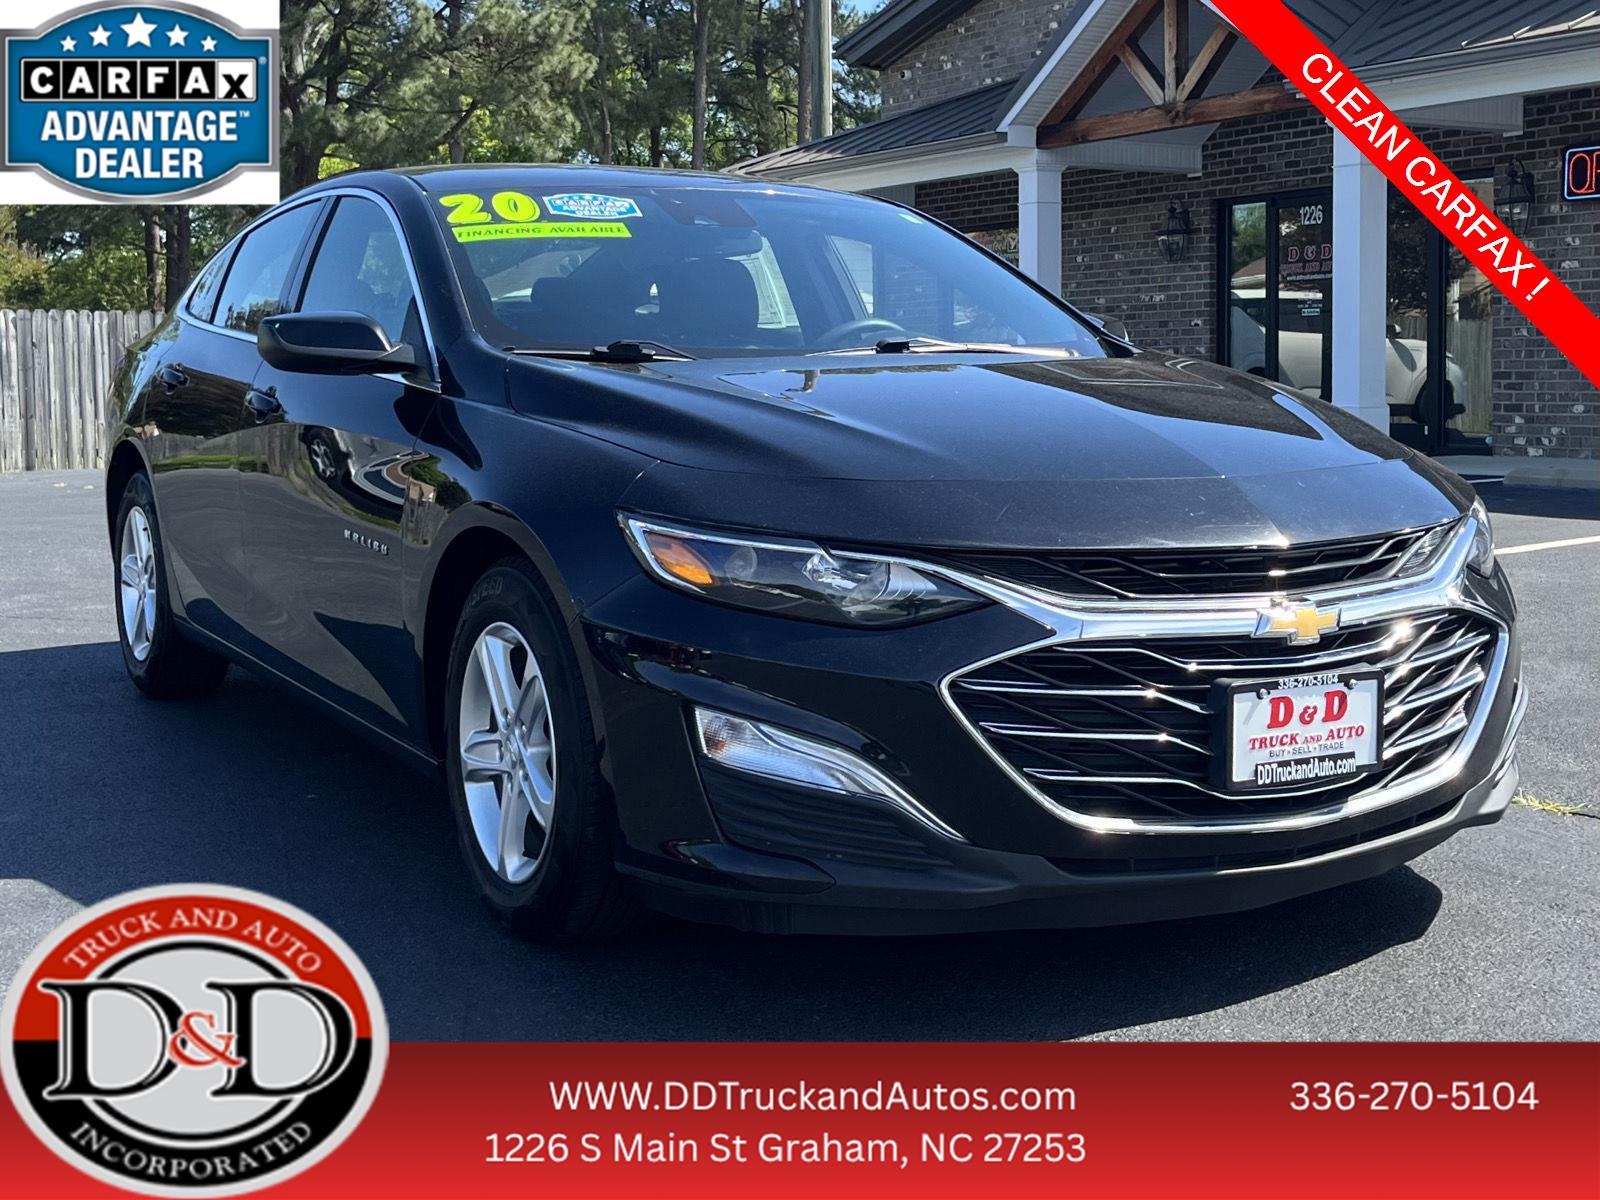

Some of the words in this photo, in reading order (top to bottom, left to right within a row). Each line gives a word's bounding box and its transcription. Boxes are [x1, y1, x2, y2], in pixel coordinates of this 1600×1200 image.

[439, 191, 540, 224] 20
[1300, 204, 1323, 225] 1226
[457, 227, 542, 238] FINANCING
[550, 226, 625, 234] AVAILABLE
[344, 528, 388, 556] MALIBU
[1277, 674, 1339, 690] 336-270-5104
[1267, 695, 1295, 730] D
[1299, 705, 1318, 725] &
[1321, 690, 1348, 723] D
[1250, 732, 1300, 750] TRUCK
[1303, 734, 1322, 744] AND
[1325, 725, 1365, 741] AUTO
[1269, 747, 1286, 758] BUY
[1292, 746, 1312, 755] SELL
[1319, 742, 1344, 751] TRADE
[1257, 756, 1357, 785] DDTruckandAuto.com
